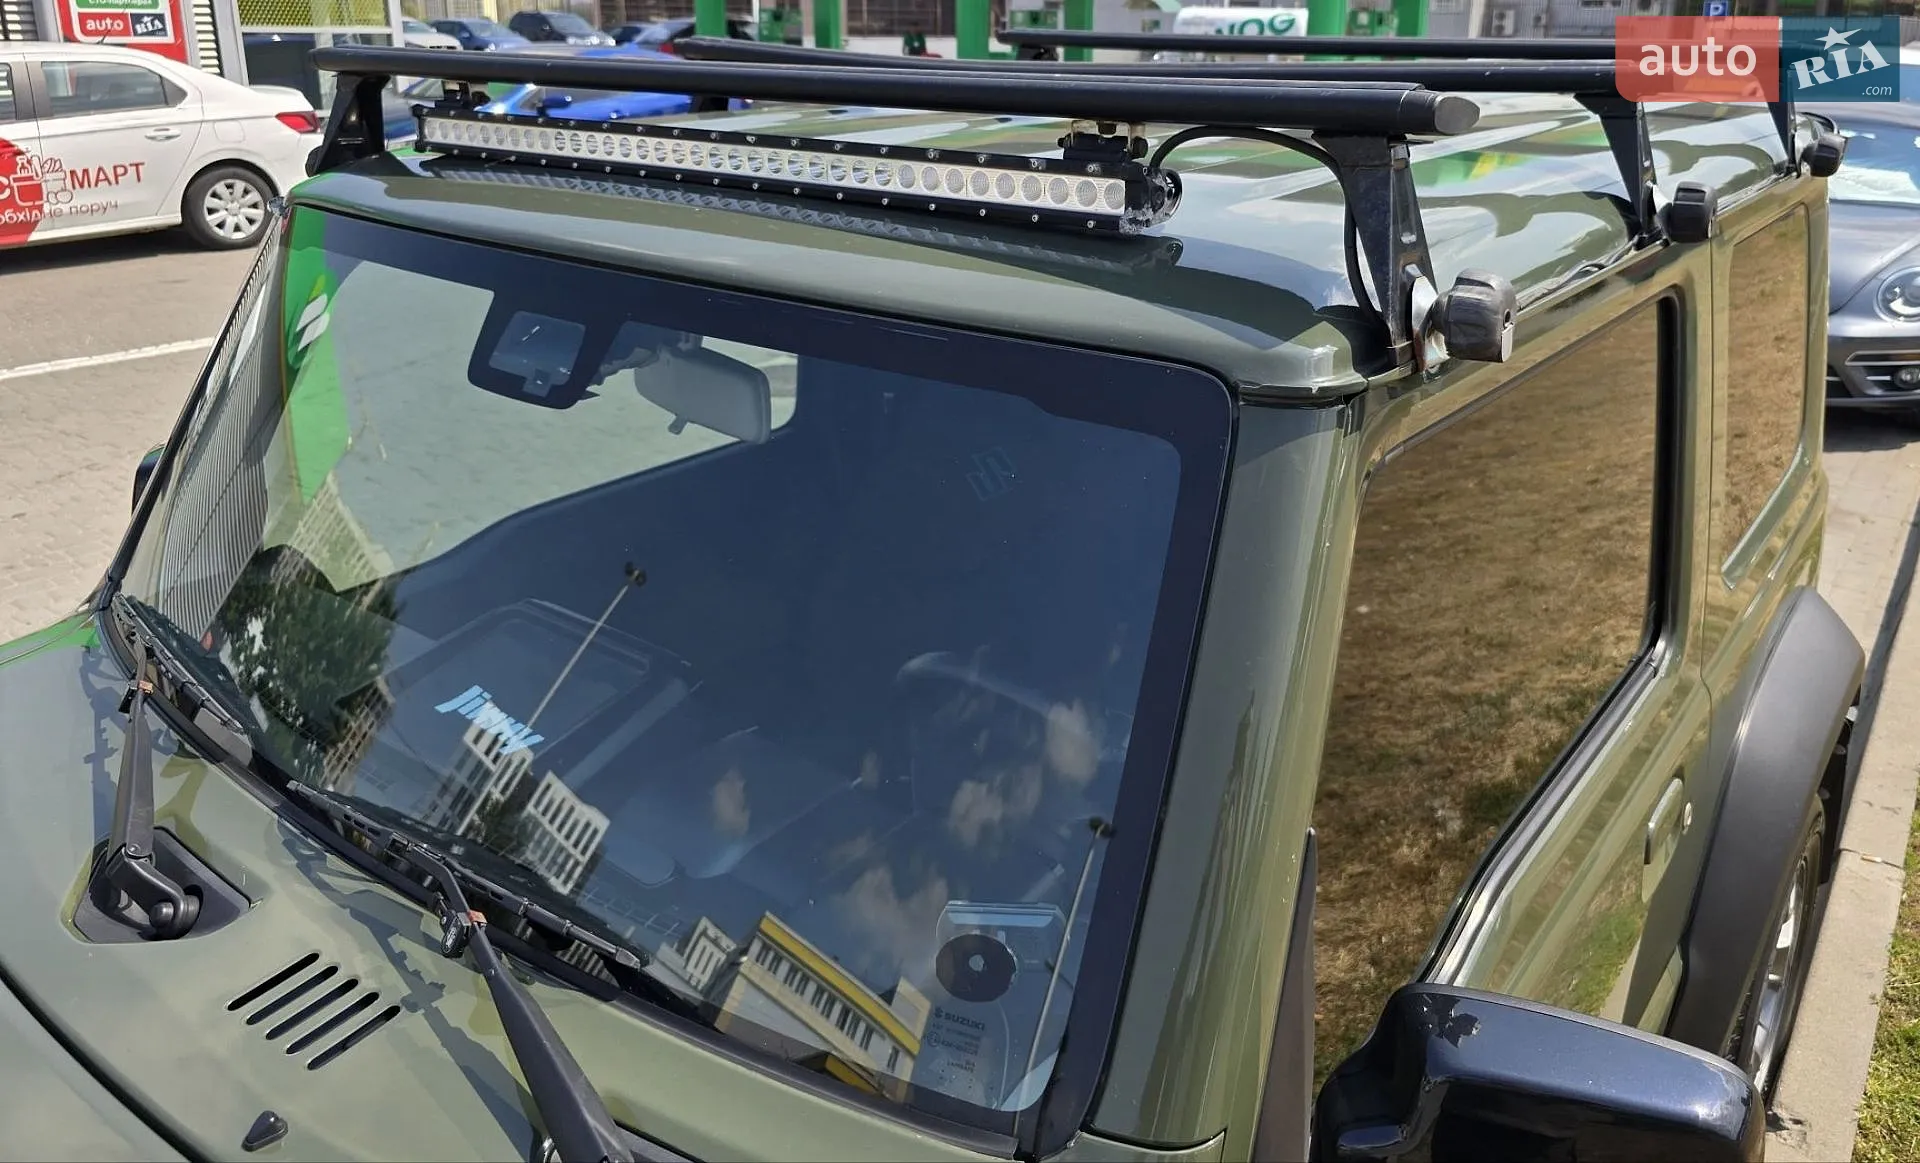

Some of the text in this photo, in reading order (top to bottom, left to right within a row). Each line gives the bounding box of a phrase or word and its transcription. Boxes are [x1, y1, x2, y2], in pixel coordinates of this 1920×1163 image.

[1710, 4, 1723, 16] P
[86, 17, 124, 31] auto
[69, 162, 146, 191] МАРТ
[69, 199, 119, 217] поруч
[944, 1011, 986, 1032] SUZUKI
